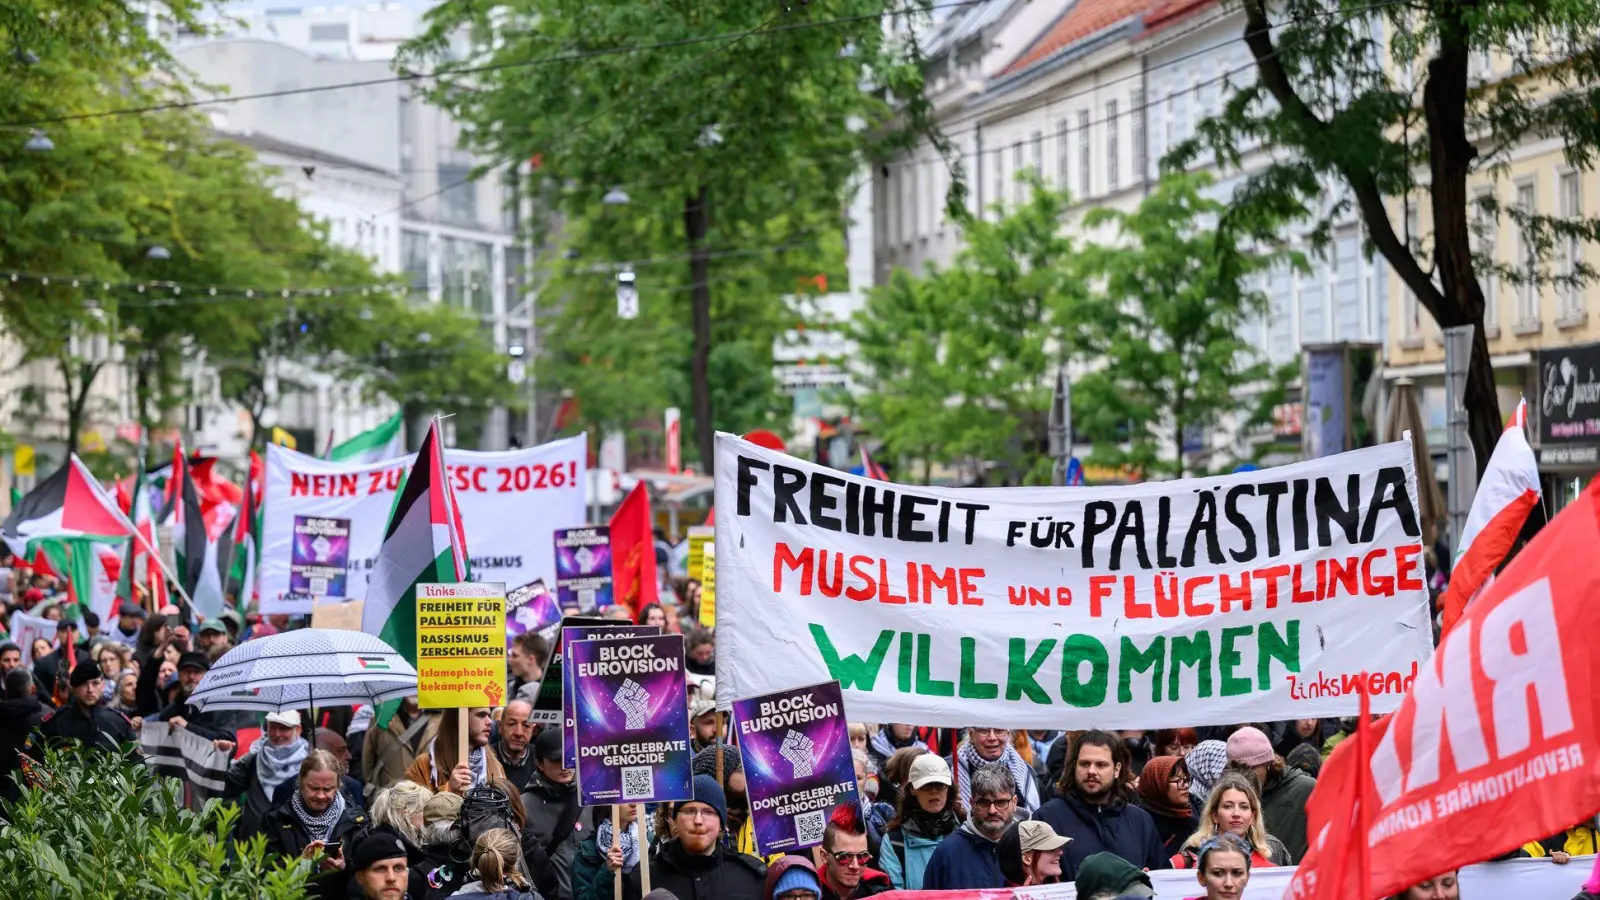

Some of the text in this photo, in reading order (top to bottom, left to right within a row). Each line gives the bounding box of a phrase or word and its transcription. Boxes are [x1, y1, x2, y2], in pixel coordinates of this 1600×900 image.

[290, 471, 359, 496] NEIN
[367, 467, 404, 496] ZU
[497, 461, 577, 493] 2026!
[737, 455, 1421, 570] FREIHEIT FÜR PALÄSTINA
[470, 556, 523, 568] NISMUS
[773, 542, 985, 605] MUSLIME
[1008, 585, 1072, 606] UND
[1089, 544, 1423, 619] FLÜCHTLINGE
[420, 599, 501, 612] FREIHEIT FÜR
[420, 613, 496, 626] PALÄSTINA!
[420, 634, 489, 644] RASSISMUS
[420, 647, 504, 657] ZERSCHLAGEN
[600, 644, 655, 661] BLOCK
[578, 657, 678, 677] EUROVISION
[808, 619, 1300, 708] WILLKOMMEN
[209, 669, 243, 682] Palestine
[420, 668, 494, 679] Islamophobie
[1286, 661, 1418, 700] linkswend
[420, 681, 482, 692] bekämpfen
[760, 693, 814, 717] BLOCK
[740, 703, 839, 735] EUROVISION
[581, 740, 686, 757] DON'T CELEBRATE
[603, 752, 665, 766] GENOCIDE
[752, 781, 854, 811] DON'T CELEBRATE
[775, 795, 835, 816] GENOCIDE
